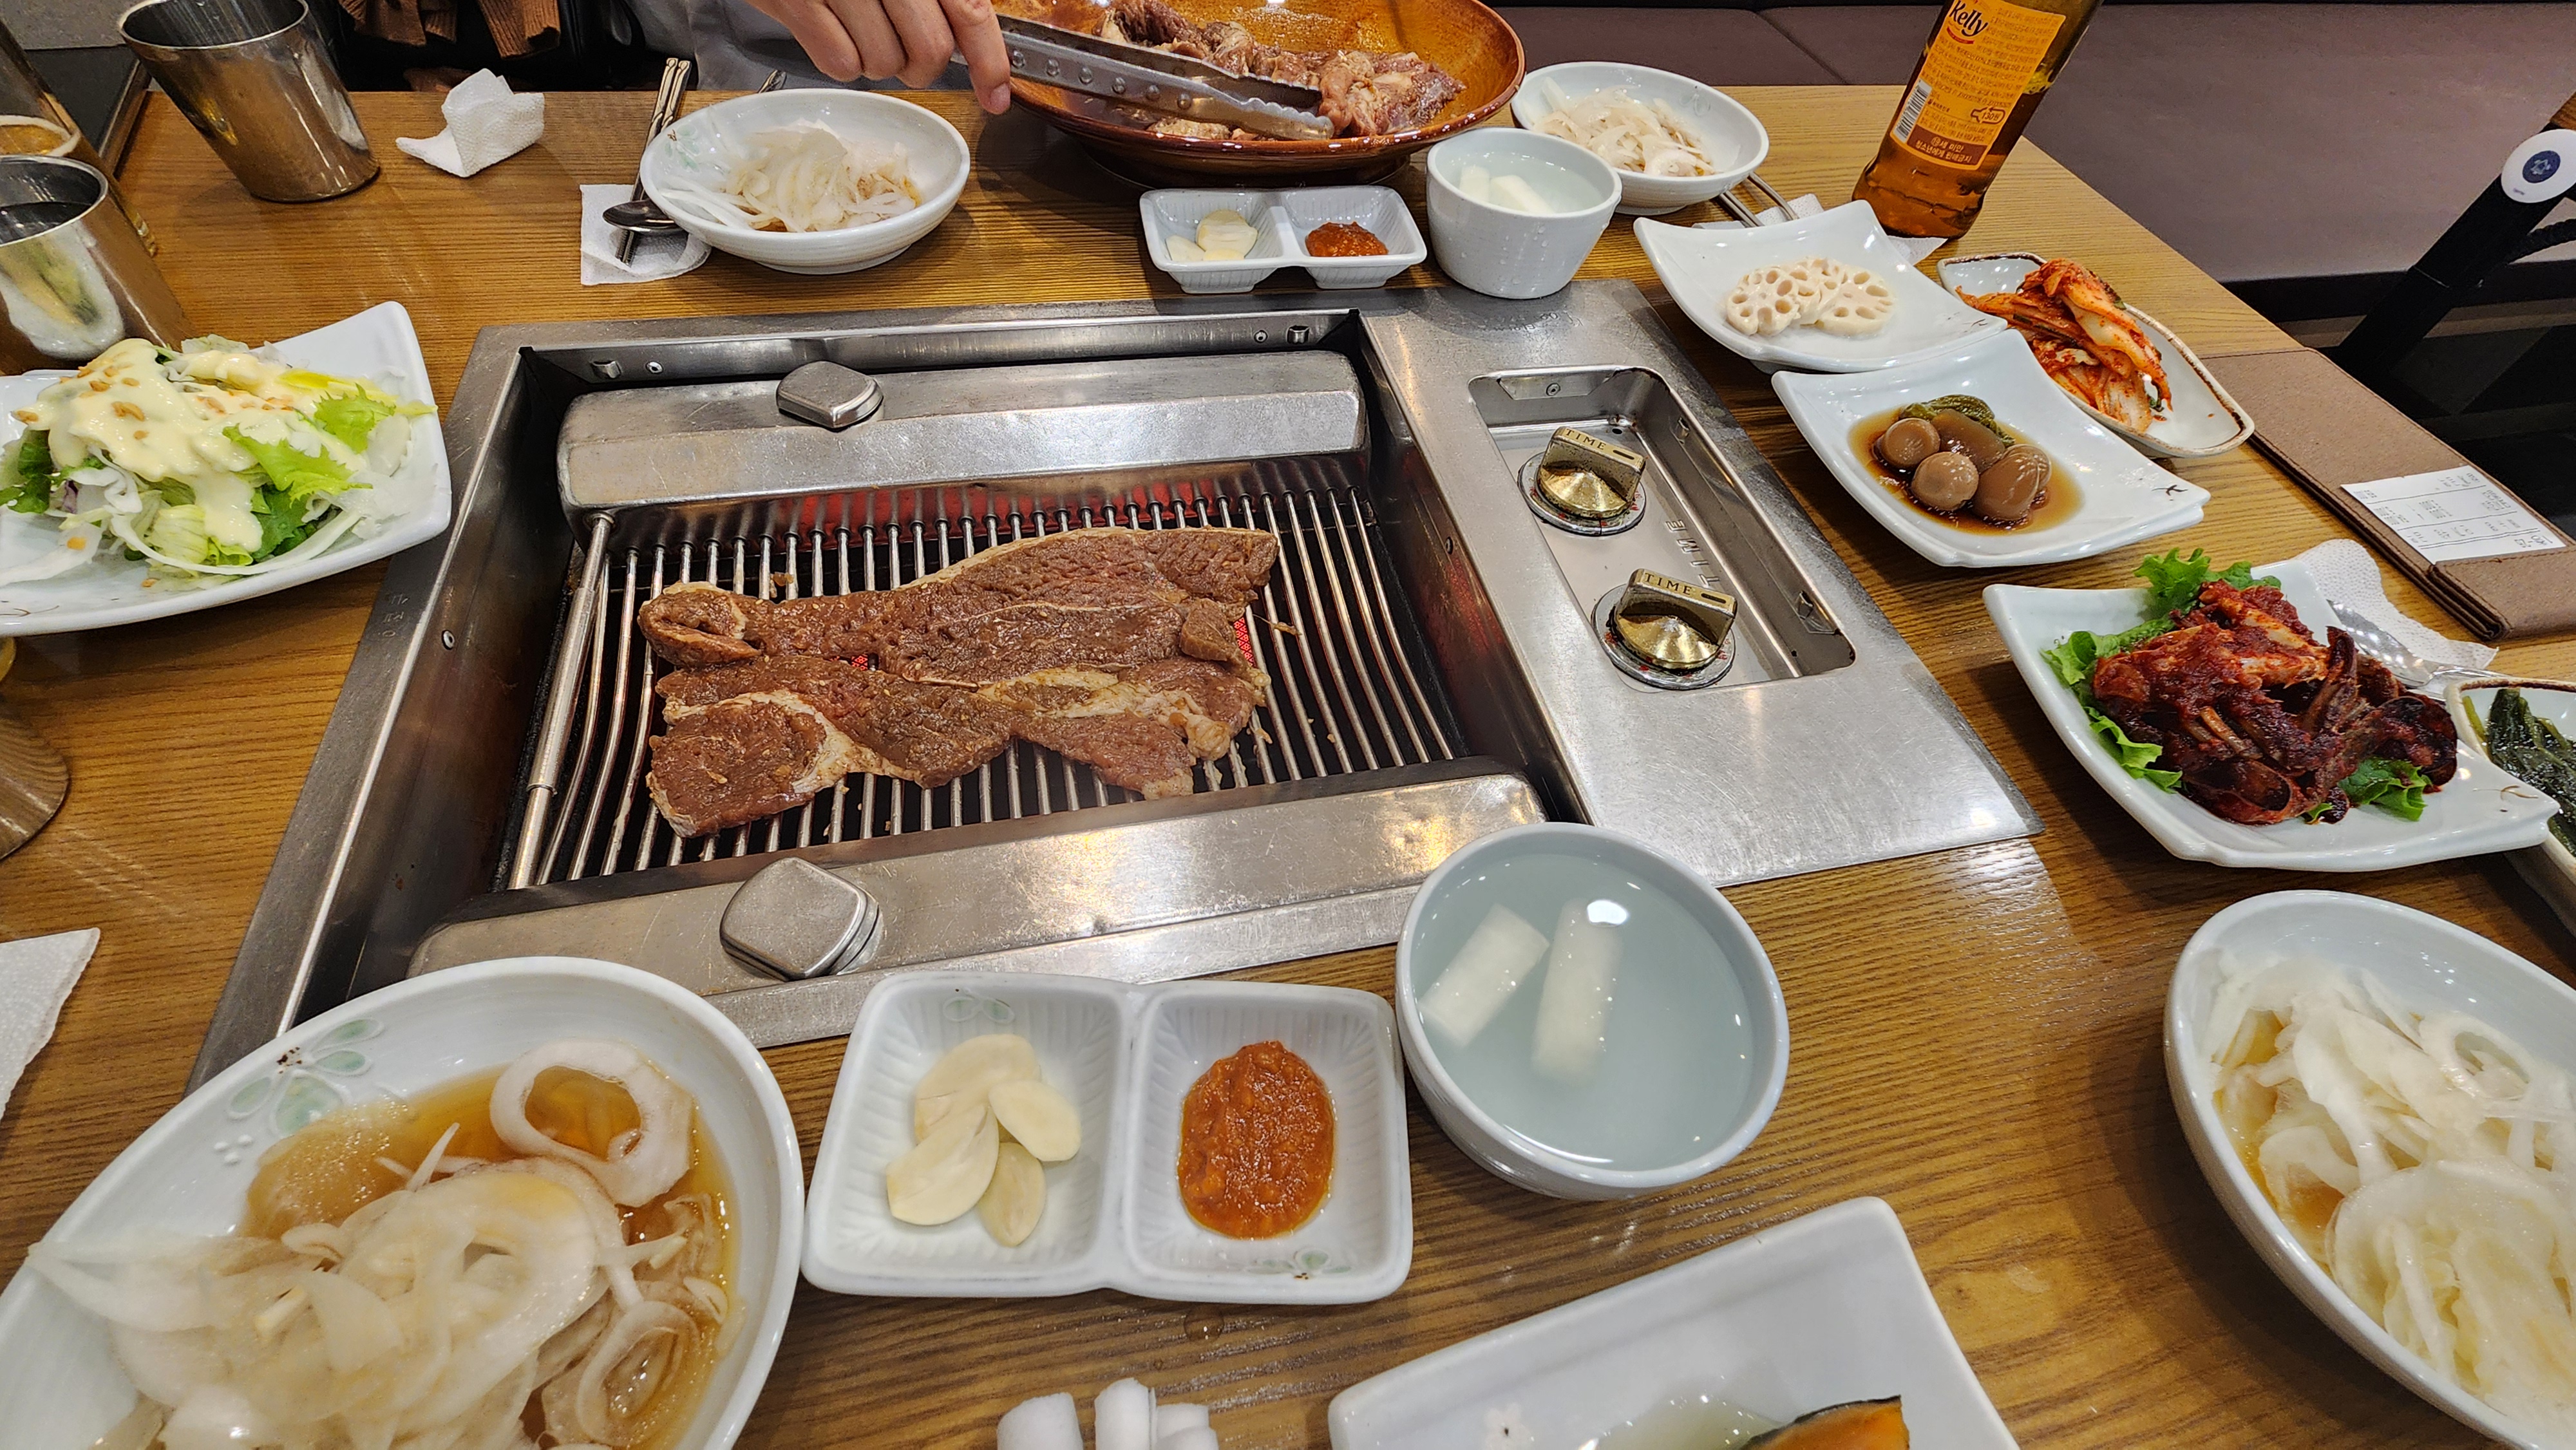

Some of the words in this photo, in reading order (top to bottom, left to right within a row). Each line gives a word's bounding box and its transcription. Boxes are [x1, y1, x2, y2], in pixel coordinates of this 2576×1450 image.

[1949, 0, 1988, 37] Kelly
[1949, 143, 1964, 153] 미만
[1566, 428, 1606, 450] TIME
[1645, 572, 1692, 596] TIME
